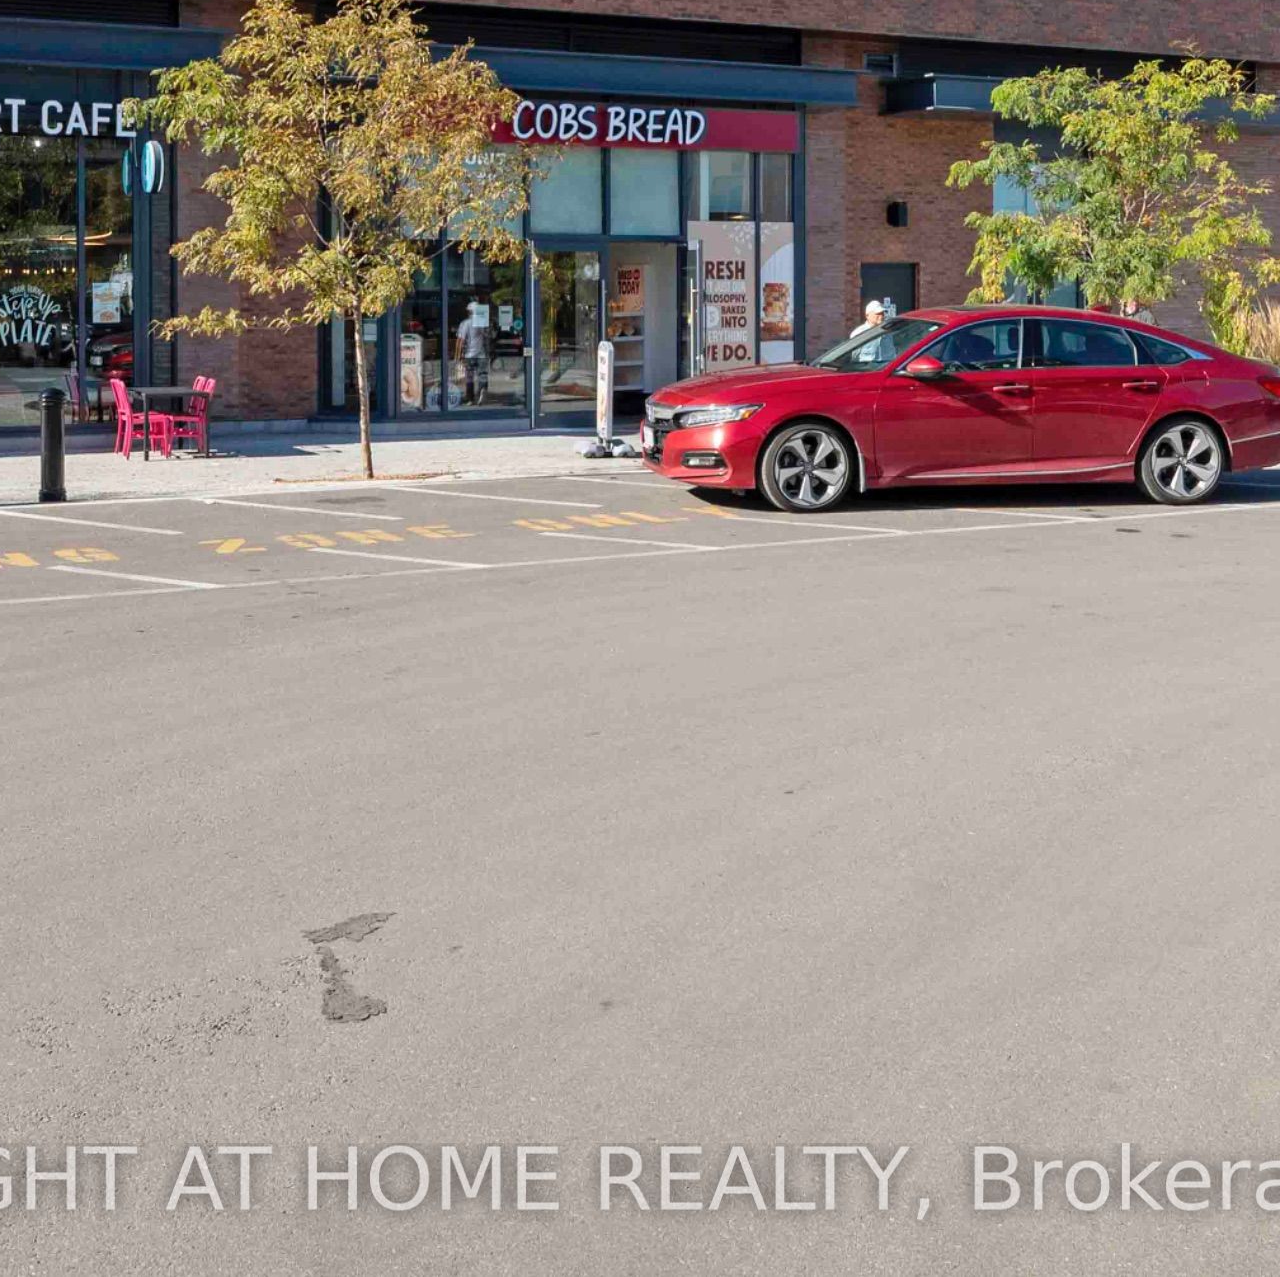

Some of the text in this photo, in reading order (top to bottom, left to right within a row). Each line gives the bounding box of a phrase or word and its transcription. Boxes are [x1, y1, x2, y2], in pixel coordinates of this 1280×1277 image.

[513, 101, 706, 145] COBS BREAD
[704, 261, 746, 280] RESH
[0, 319, 56, 347] PLATE
[721, 315, 748, 328] INTO
[722, 343, 751, 361] DO.
[197, 523, 483, 554] ZONE
[512, 506, 735, 531] ONLY
